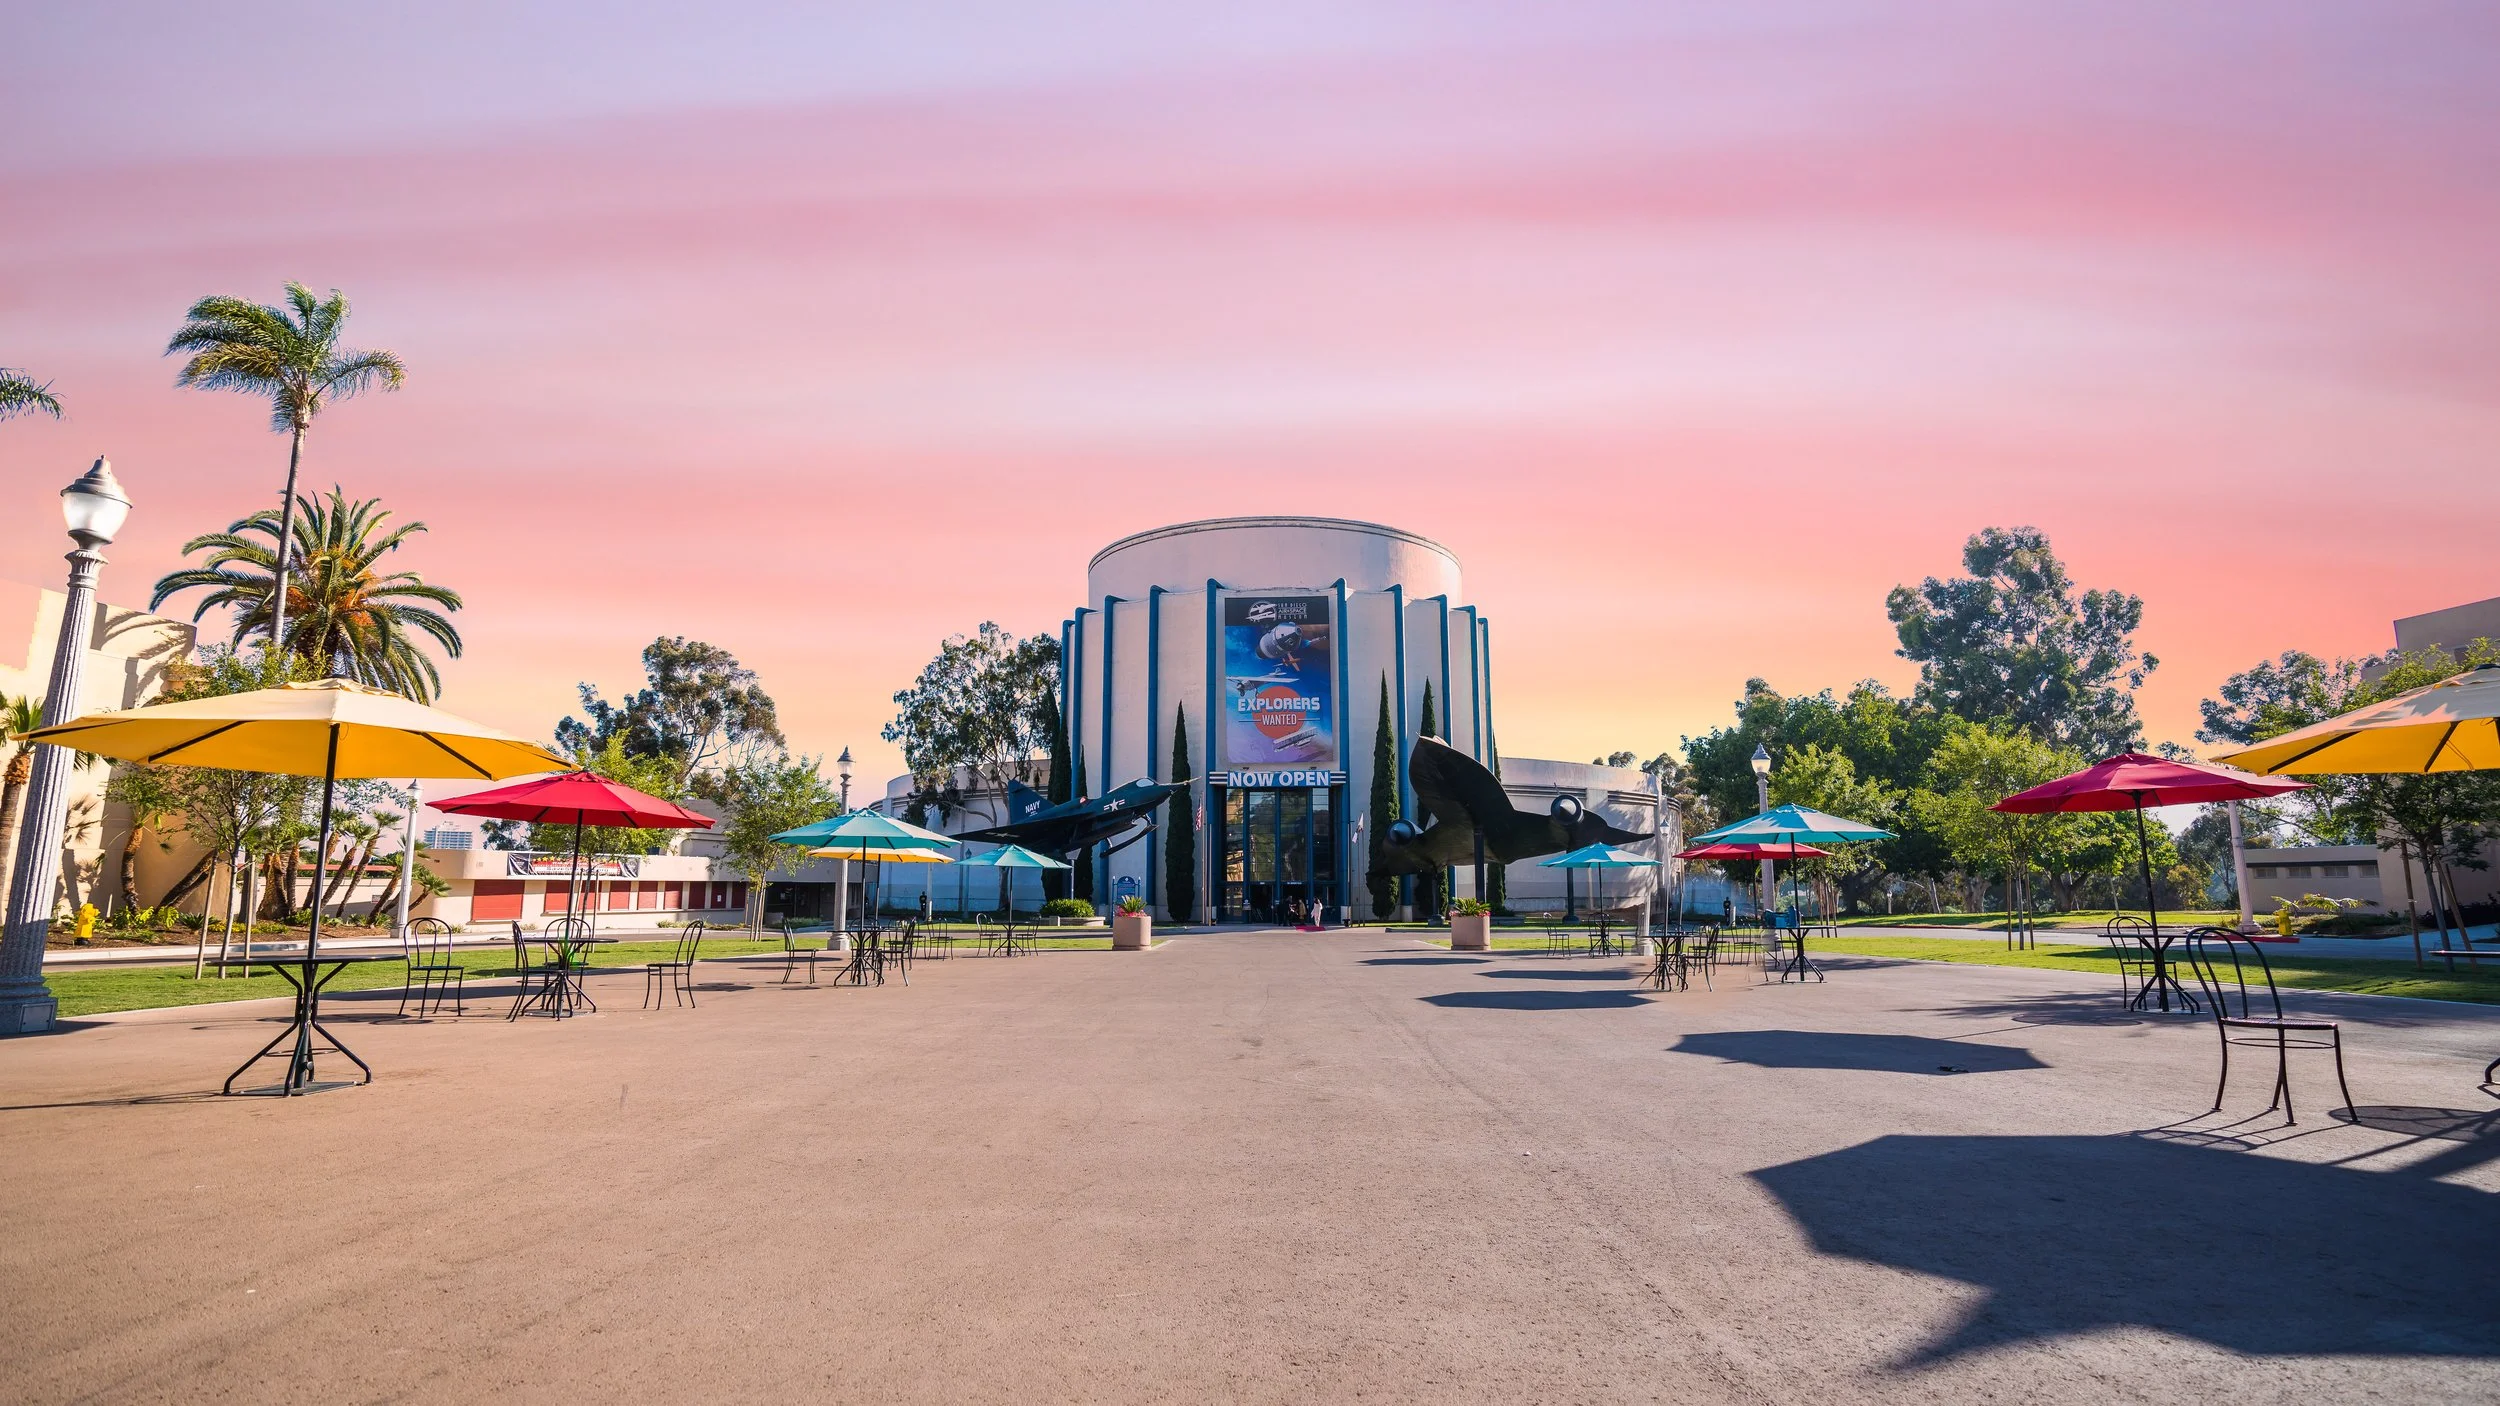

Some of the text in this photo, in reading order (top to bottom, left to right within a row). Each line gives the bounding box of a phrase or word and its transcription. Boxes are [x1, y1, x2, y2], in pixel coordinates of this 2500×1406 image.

[1238, 697, 1320, 712] EXPLORERS
[1262, 714, 1297, 725] WANTED
[1229, 771, 1329, 787] NOW OPEN
[1025, 800, 1040, 813] NAVY
